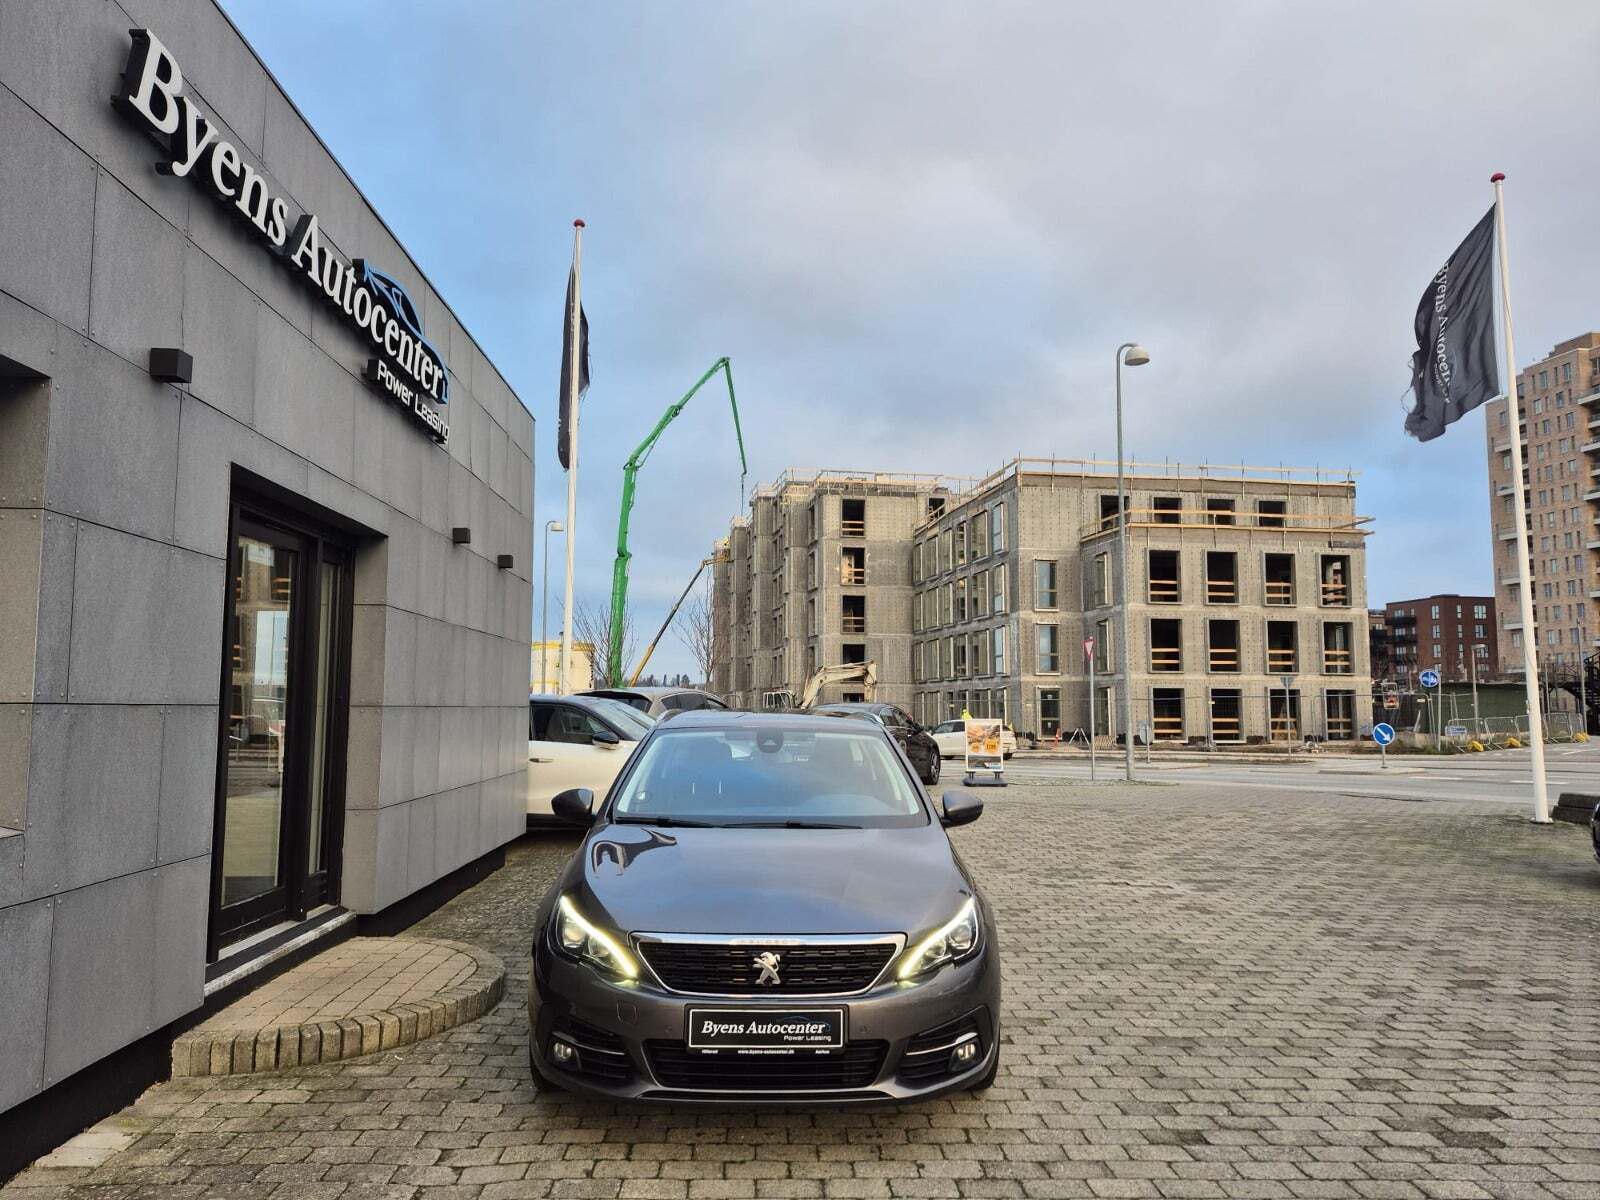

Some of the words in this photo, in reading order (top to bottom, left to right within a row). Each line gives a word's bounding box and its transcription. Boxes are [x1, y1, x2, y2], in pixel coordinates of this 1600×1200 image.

[128, 28, 289, 247] Byens
[291, 214, 443, 399] Autocenter
[377, 359, 414, 407] Power
[414, 393, 450, 445] Leasing
[701, 1020, 745, 1037] Byens
[746, 1020, 826, 1034] Autocenter
